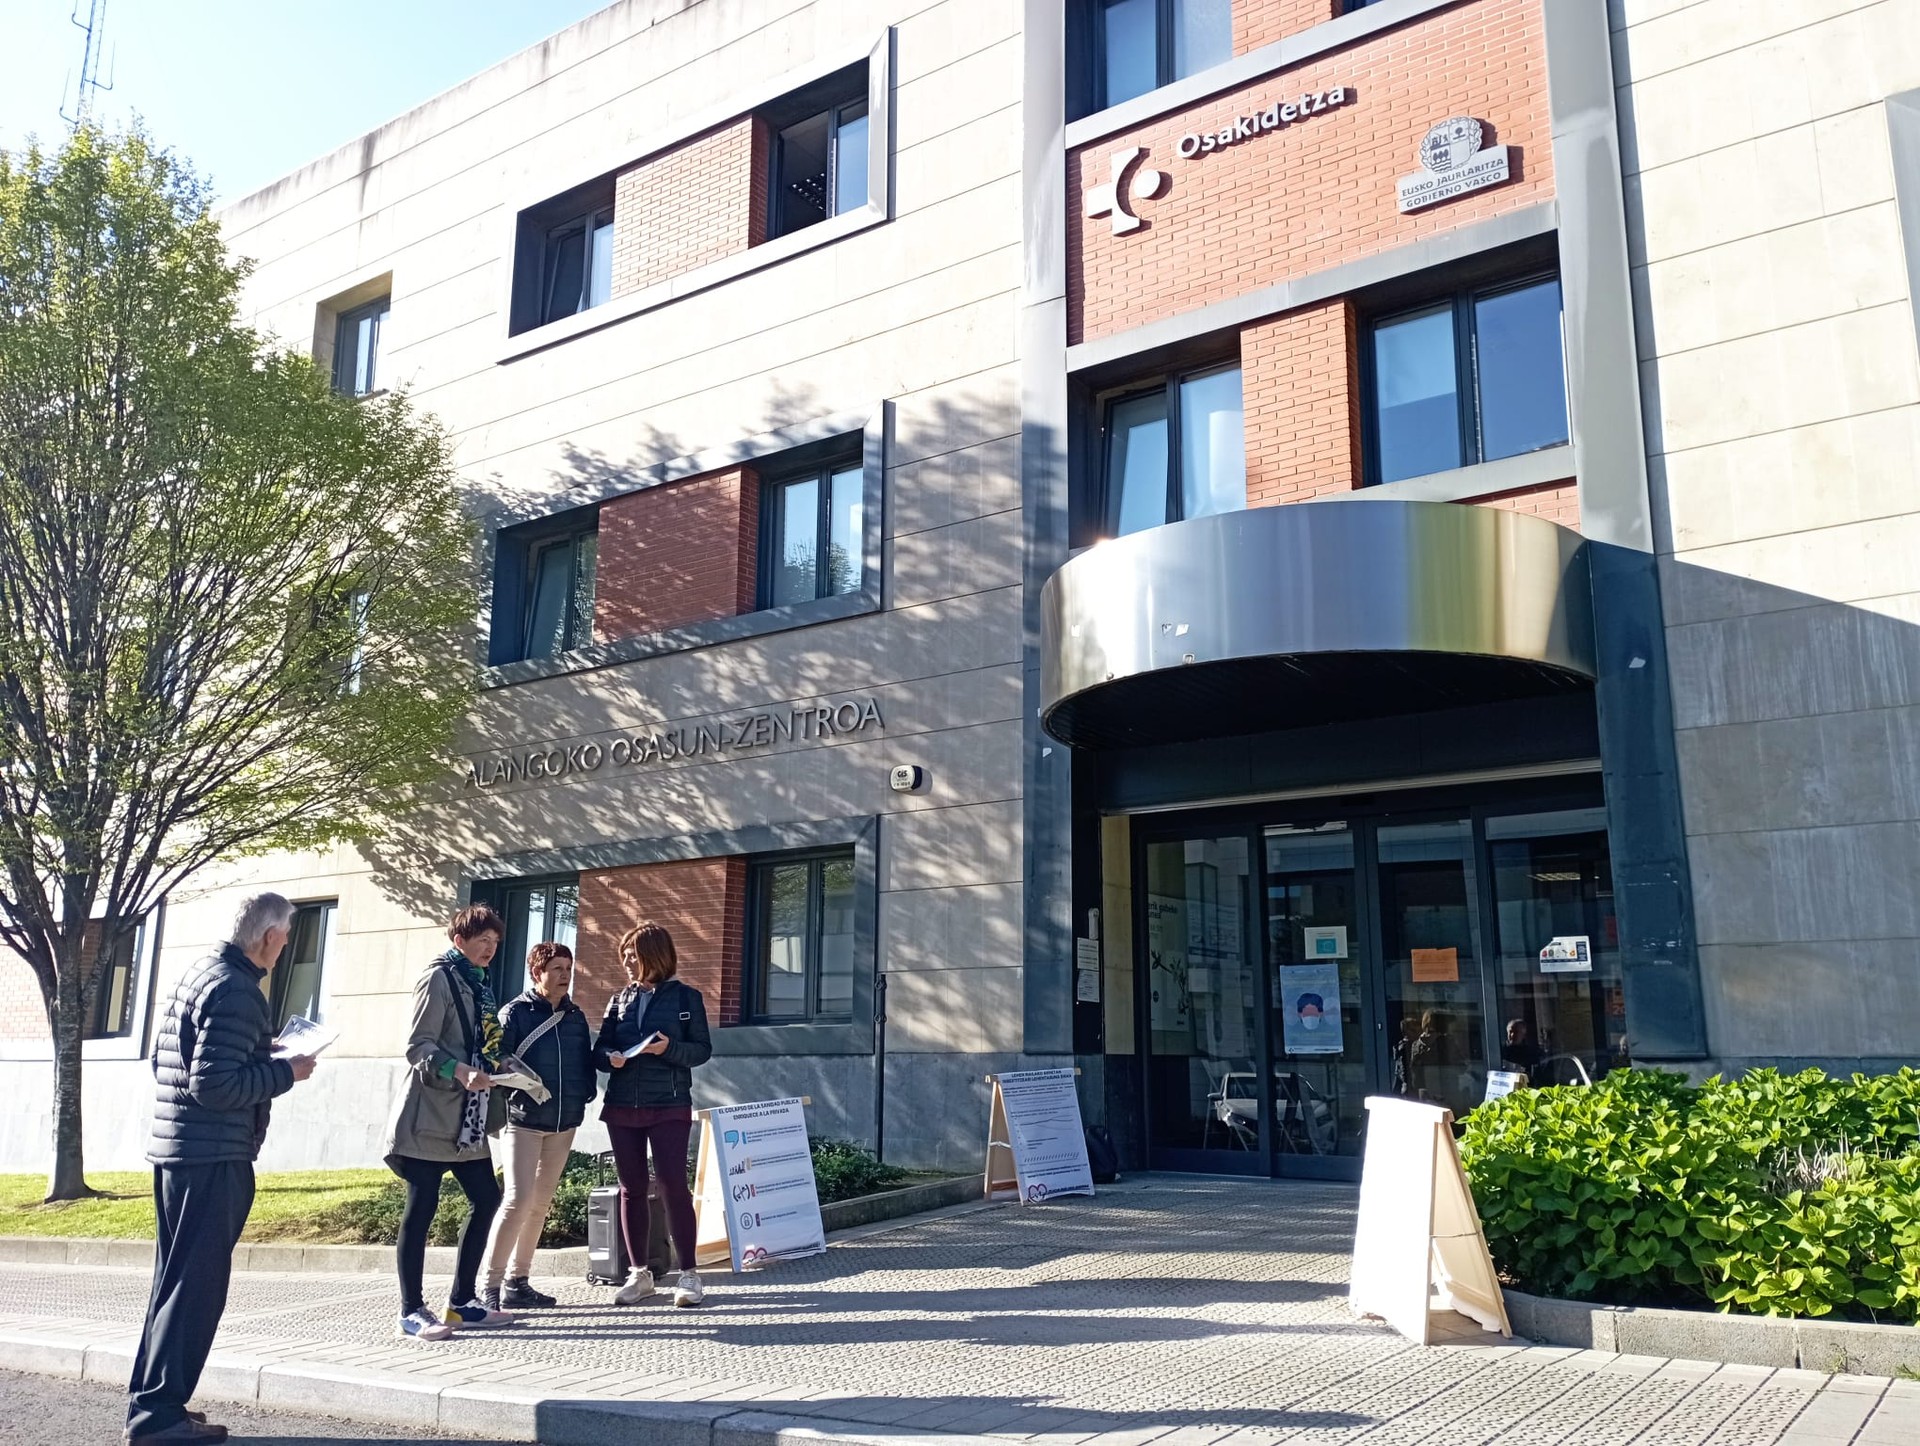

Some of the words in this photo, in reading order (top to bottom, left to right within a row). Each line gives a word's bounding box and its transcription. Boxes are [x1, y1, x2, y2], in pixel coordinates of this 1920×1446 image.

[1176, 86, 1344, 159] Osakidetza
[1402, 180, 1433, 197] EUSKO
[1437, 158, 1504, 187] JAURLARITZA
[1406, 184, 1462, 208] GOBIERNO
[1465, 172, 1501, 188] VASCO
[465, 742, 603, 789] ALANGOKO
[610, 698, 885, 766] OSASUN-ZENTROA
[725, 1105, 747, 1114] COLAPSO
[733, 1111, 758, 1120] ENRIQUECE
[770, 1107, 790, 1115] PRIVADA
